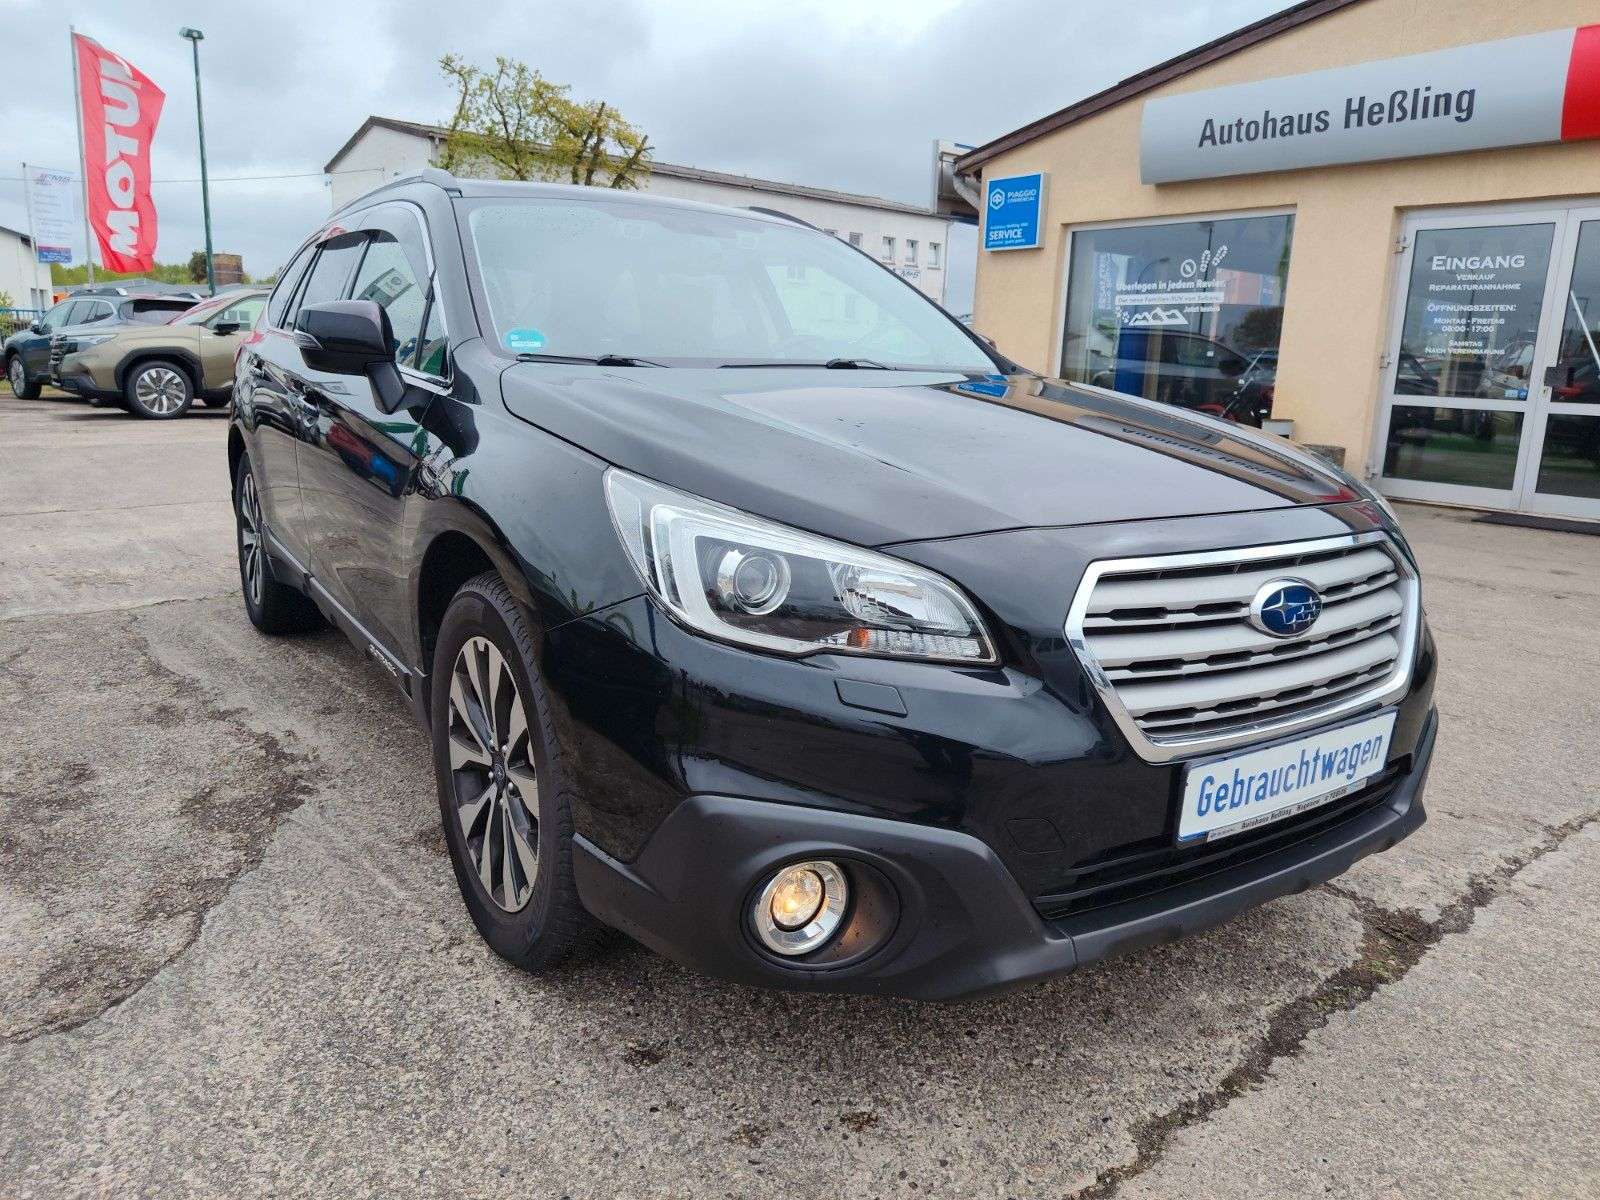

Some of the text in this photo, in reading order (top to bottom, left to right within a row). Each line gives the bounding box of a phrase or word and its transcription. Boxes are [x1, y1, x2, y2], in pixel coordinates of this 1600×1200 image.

[1198, 86, 1476, 148] Autohaus Heßling
[989, 228, 1023, 240] SERVICE
[1431, 255, 1526, 271] EINGANG
[1159, 280, 1166, 290] in
[1167, 279, 1195, 291] jedem
[1197, 734, 1383, 817] Gebrauchtwagen
